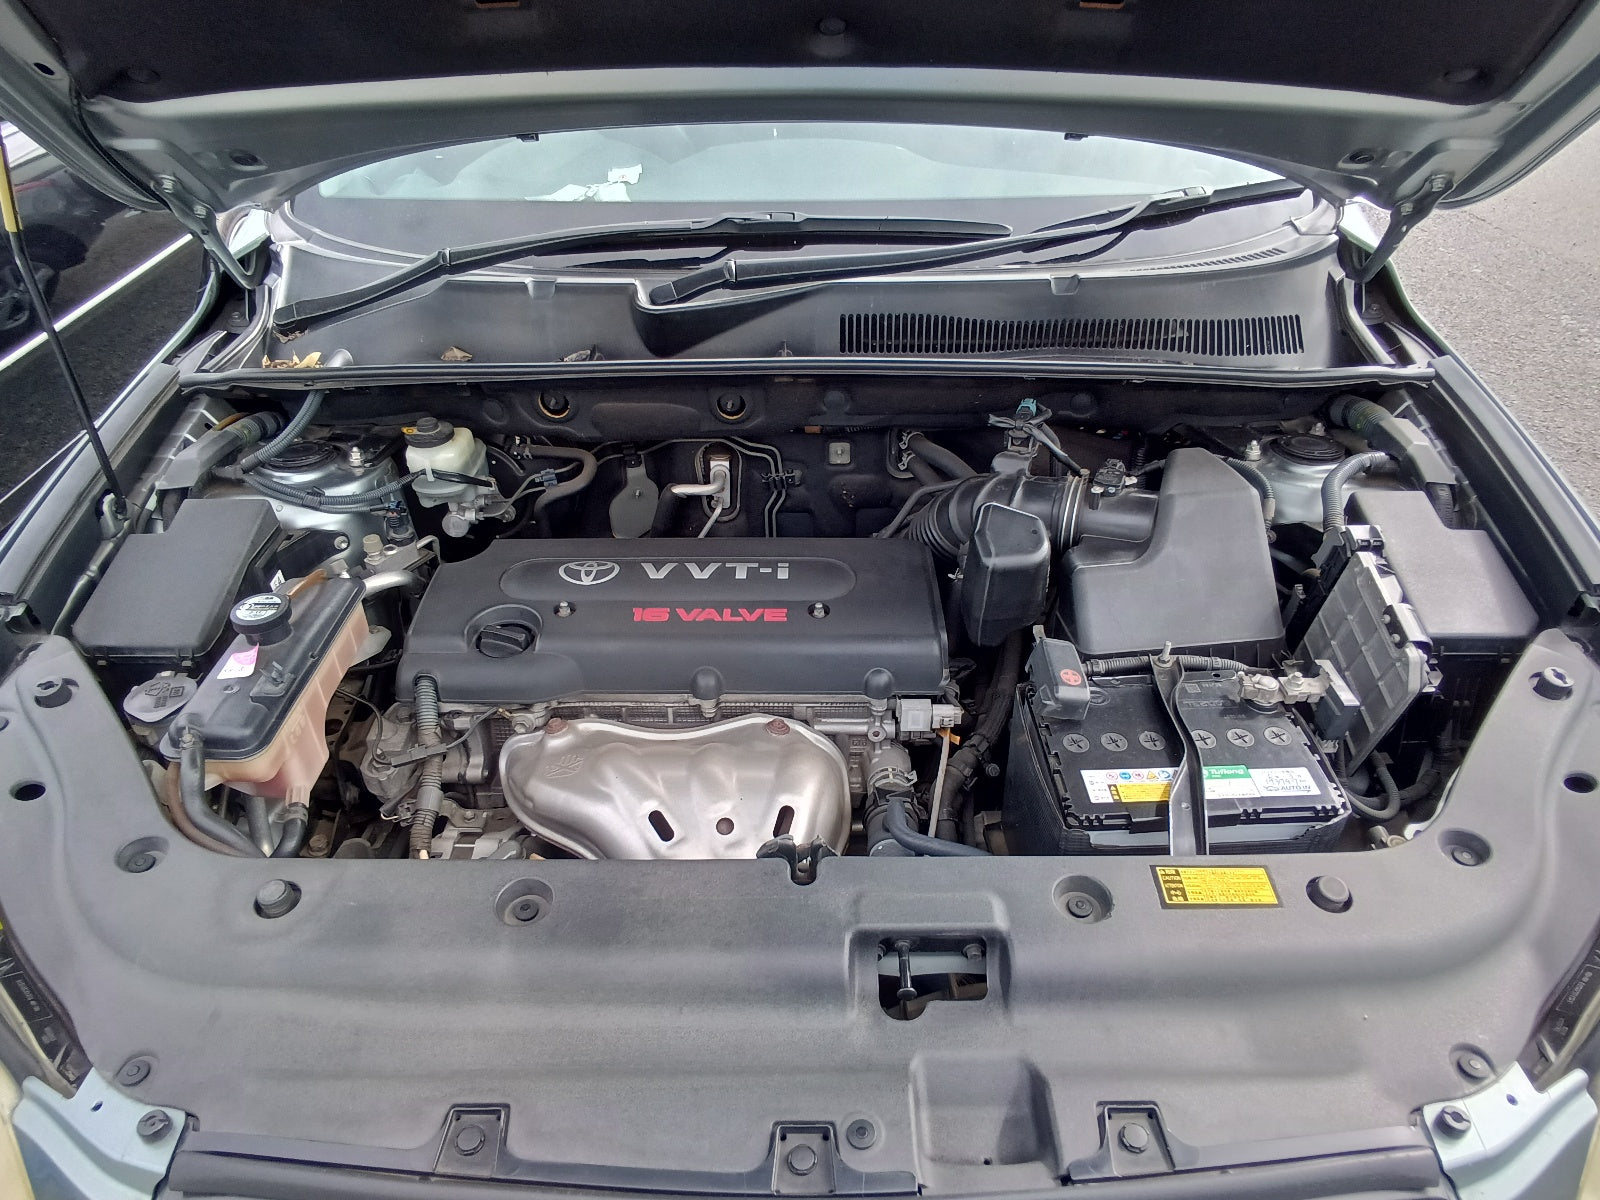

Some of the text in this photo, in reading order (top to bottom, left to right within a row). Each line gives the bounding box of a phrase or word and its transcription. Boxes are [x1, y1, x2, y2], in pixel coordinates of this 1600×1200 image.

[640, 562, 789, 579] VVT-i
[632, 608, 787, 622] 16 VALVE
